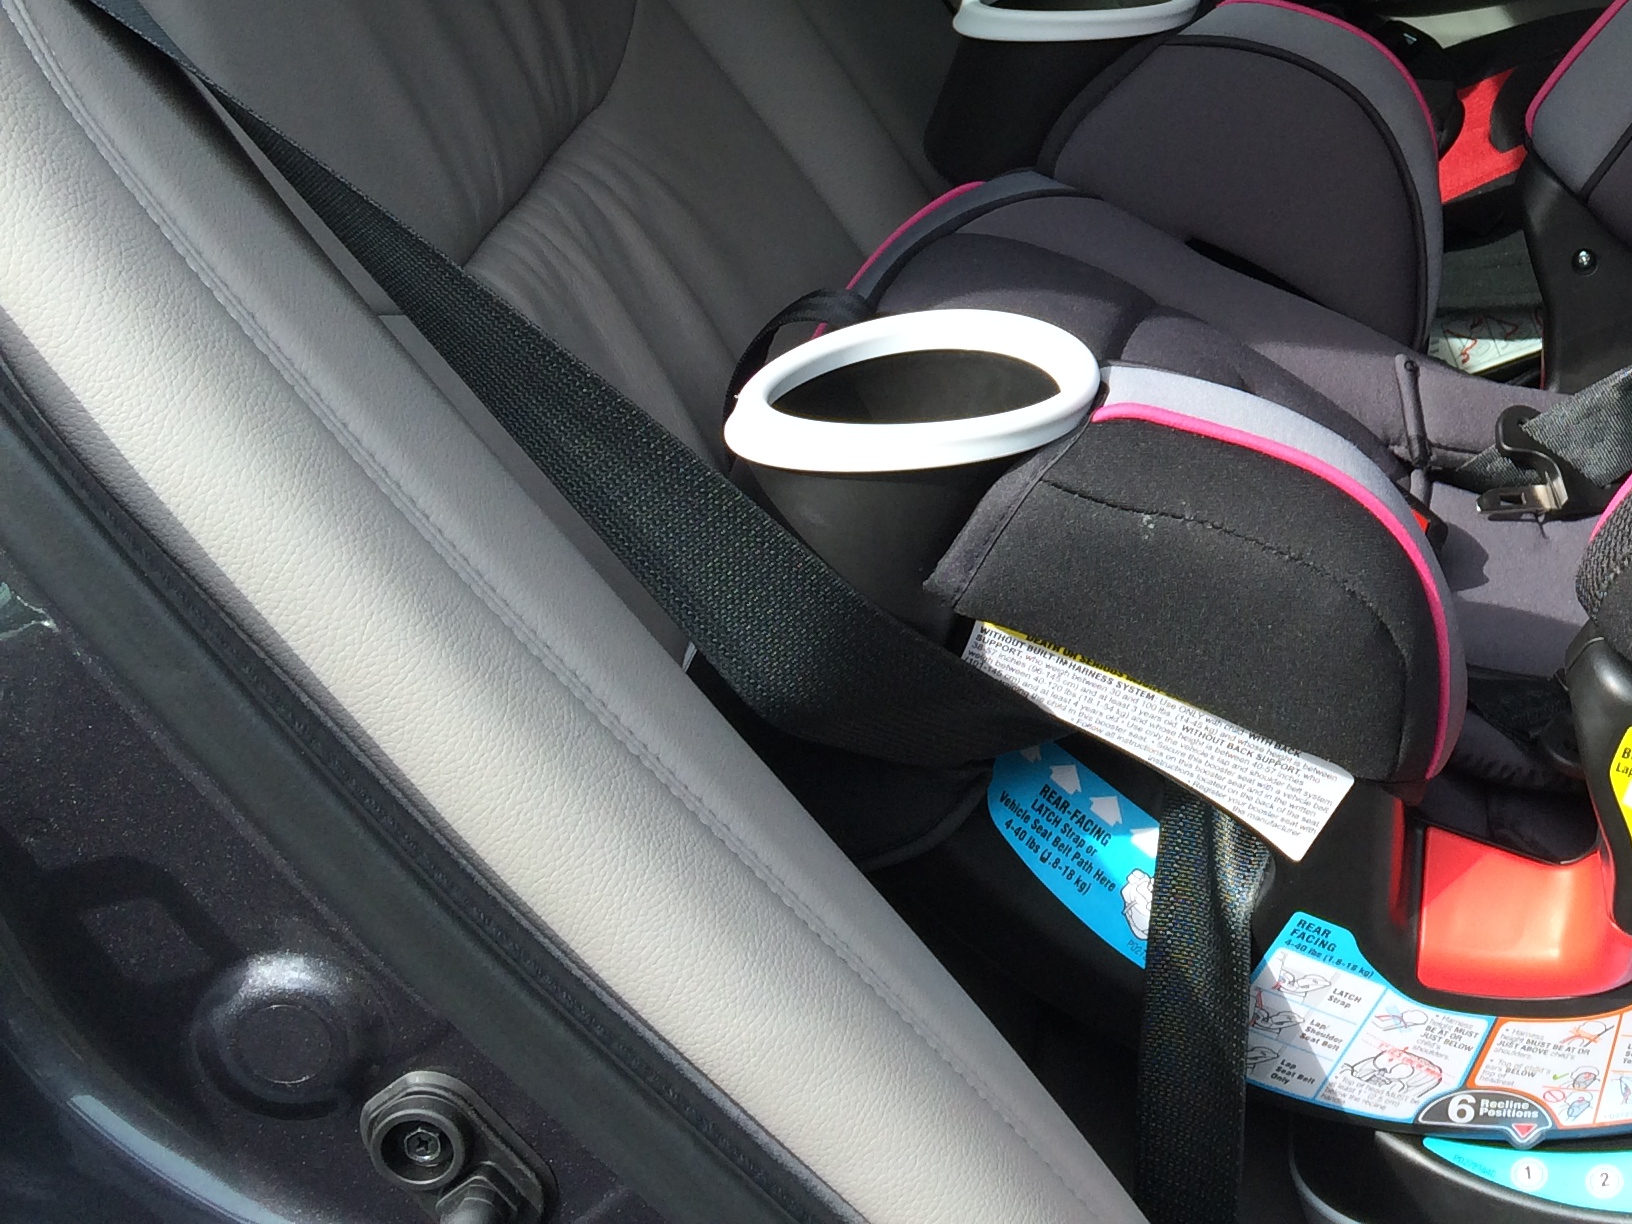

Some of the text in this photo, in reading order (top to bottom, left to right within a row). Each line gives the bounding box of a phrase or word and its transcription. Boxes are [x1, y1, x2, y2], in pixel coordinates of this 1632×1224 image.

[975, 633, 1023, 658] SUPPORT,
[979, 625, 1026, 648] WITHOUT
[1067, 661, 1114, 685] HARNESS
[1181, 724, 1300, 777] WITHOUT BACK SUPPORT,
[1039, 783, 1111, 847] REAR-FACING
[1030, 798, 1097, 857] LATCH Strap or
[999, 789, 1116, 892] Vehicle Seat Belt Path Here
[1004, 818, 1027, 841] 4-40
[1024, 835, 1040, 853] lbs
[1073, 874, 1091, 896] kg)
[1296, 918, 1331, 938] REAR
[1284, 938, 1307, 952] 4-40
[1307, 947, 1322, 958] lbs
[1289, 928, 1336, 952] FACING
[1327, 987, 1361, 1008] LATCH Strap
[1299, 1032, 1339, 1051] Seat Belt
[1304, 1025, 1342, 1043] Shoulder
[1419, 1031, 1473, 1051] JUST BELOW
[1424, 1024, 1462, 1041] BE AT OR
[1453, 1026, 1479, 1038] MUST
[1496, 1039, 1548, 1055] JUST ABOVE
[1525, 1038, 1551, 1048] MUST
[1279, 1058, 1296, 1069] Lap
[1270, 1072, 1290, 1085] Only
[1275, 1065, 1315, 1084] Seat Belt
[1447, 1092, 1529, 1123] 6 Recline
[1479, 1105, 1538, 1118] Positions
[1525, 1165, 1531, 1179] 1
[1600, 1172, 1608, 1186] 2
